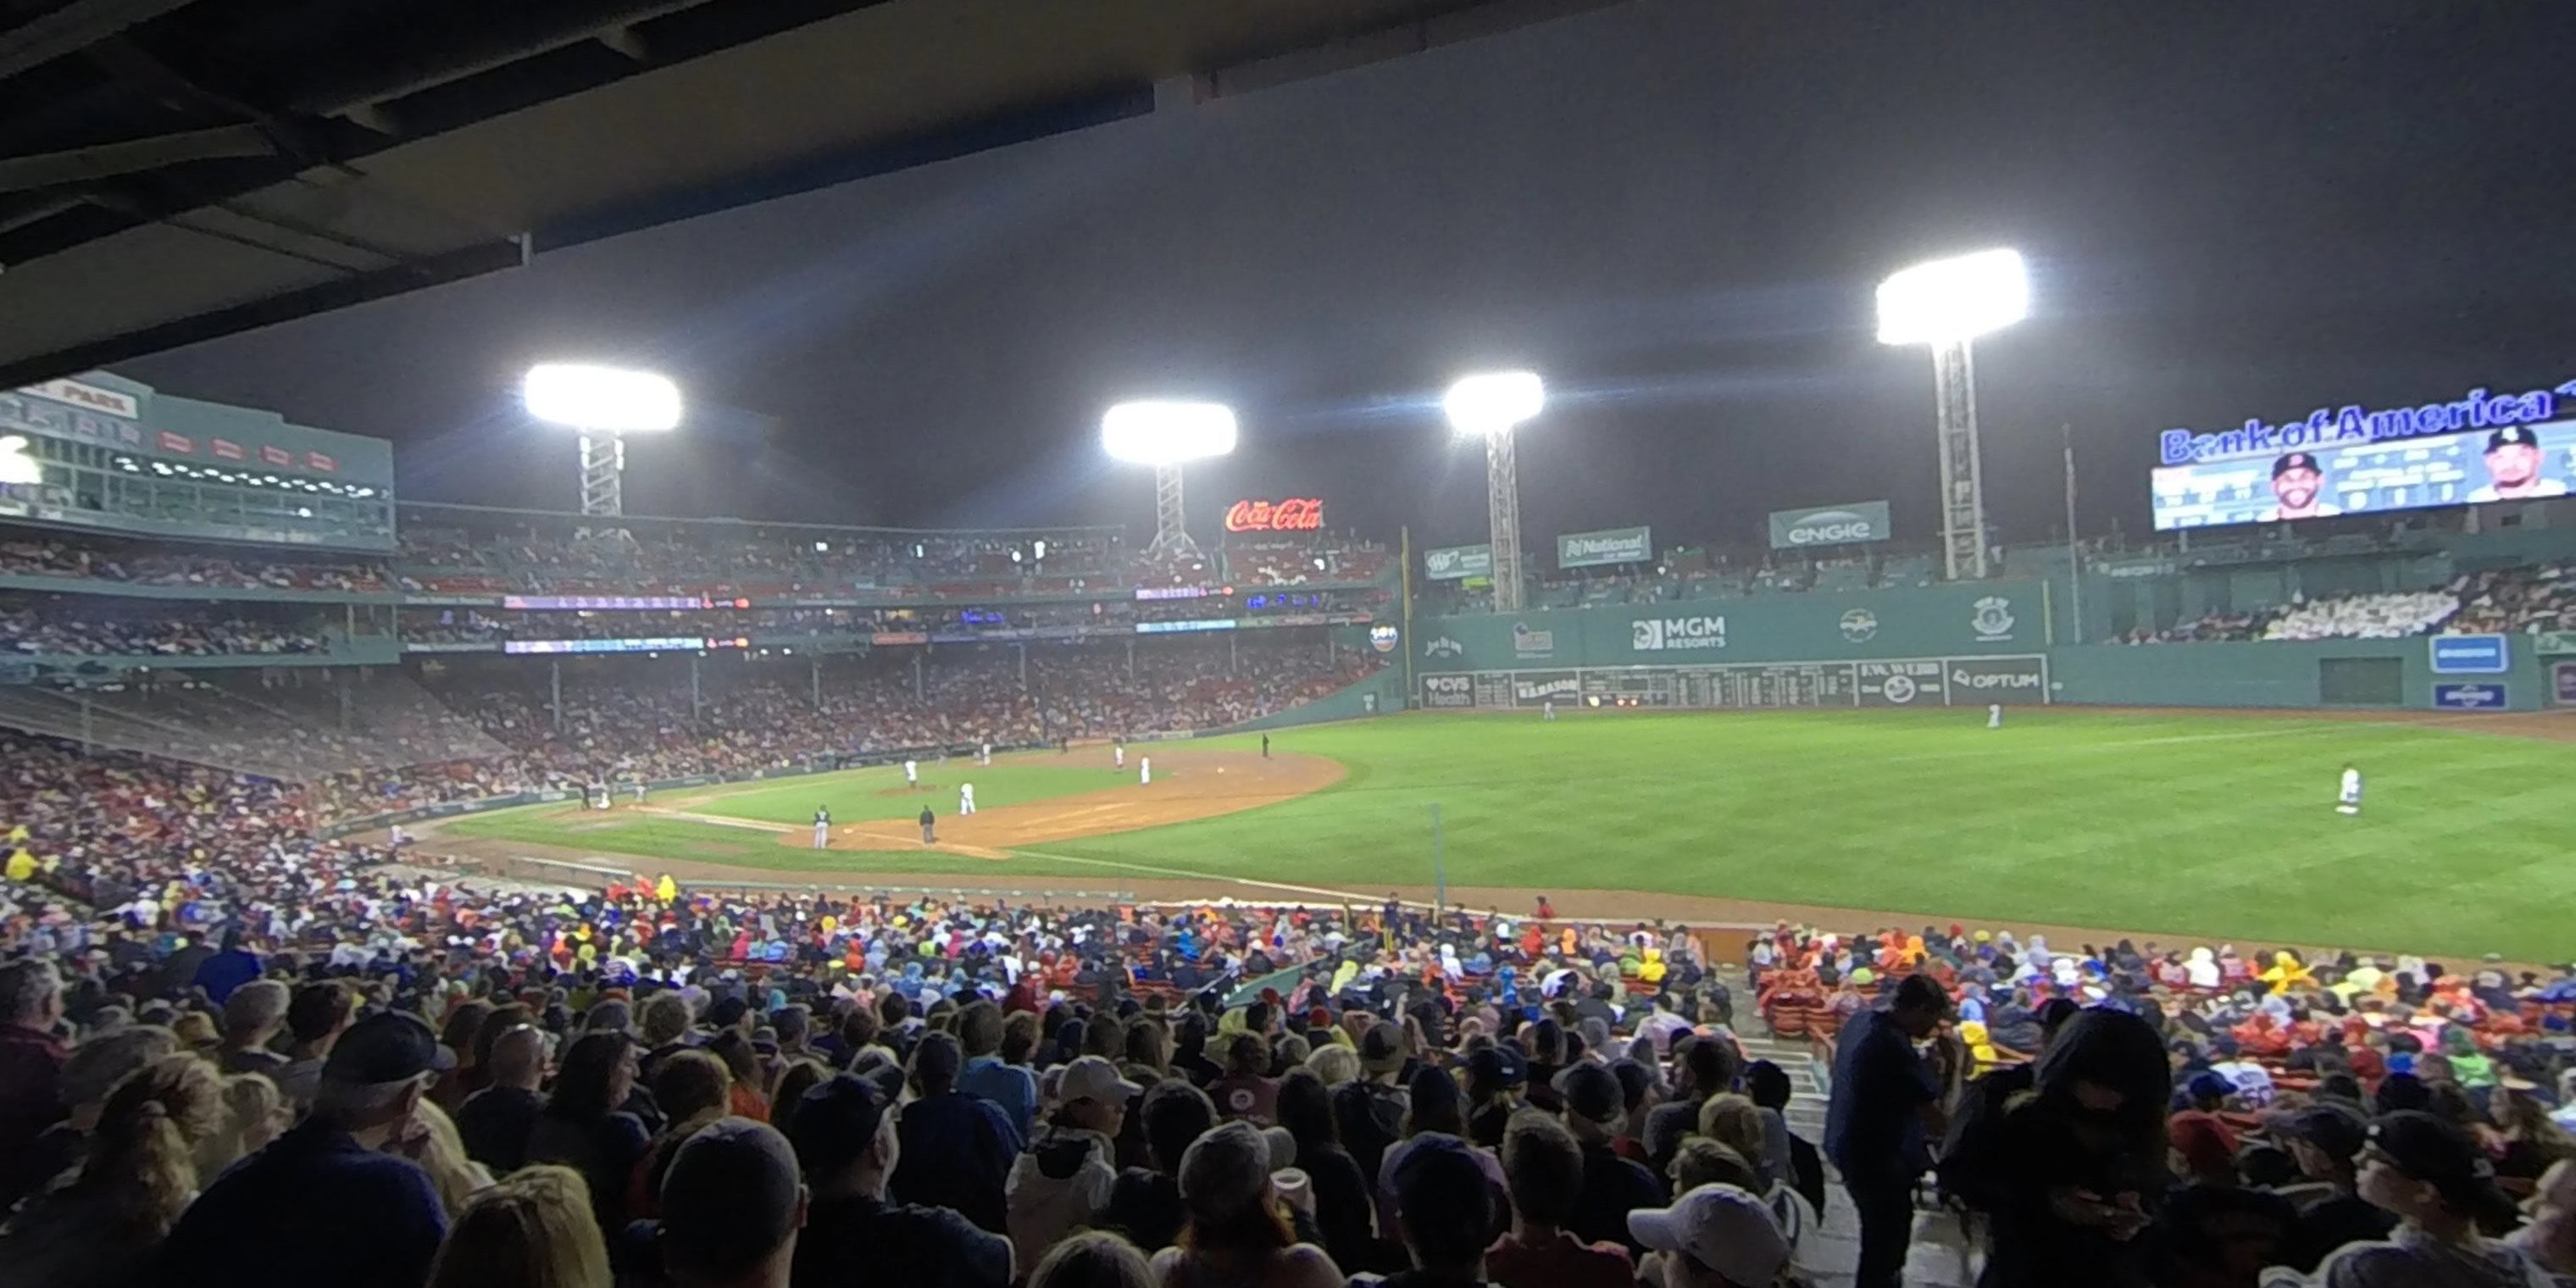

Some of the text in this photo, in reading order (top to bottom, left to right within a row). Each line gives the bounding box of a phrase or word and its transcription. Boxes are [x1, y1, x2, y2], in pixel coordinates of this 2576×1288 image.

[64, 385, 126, 412] PARK
[2161, 418, 2276, 465] Bank
[2279, 408, 2332, 447] of
[2335, 388, 2554, 443] America
[1226, 498, 1323, 531] Coca-Cola
[1583, 534, 1643, 554] National
[1665, 616, 1725, 637] MGM
[1667, 636, 1726, 649] RESORTS
[1440, 676, 1470, 691] CVS
[1973, 674, 2040, 688] OPTUM
[1428, 691, 1471, 706] Health
